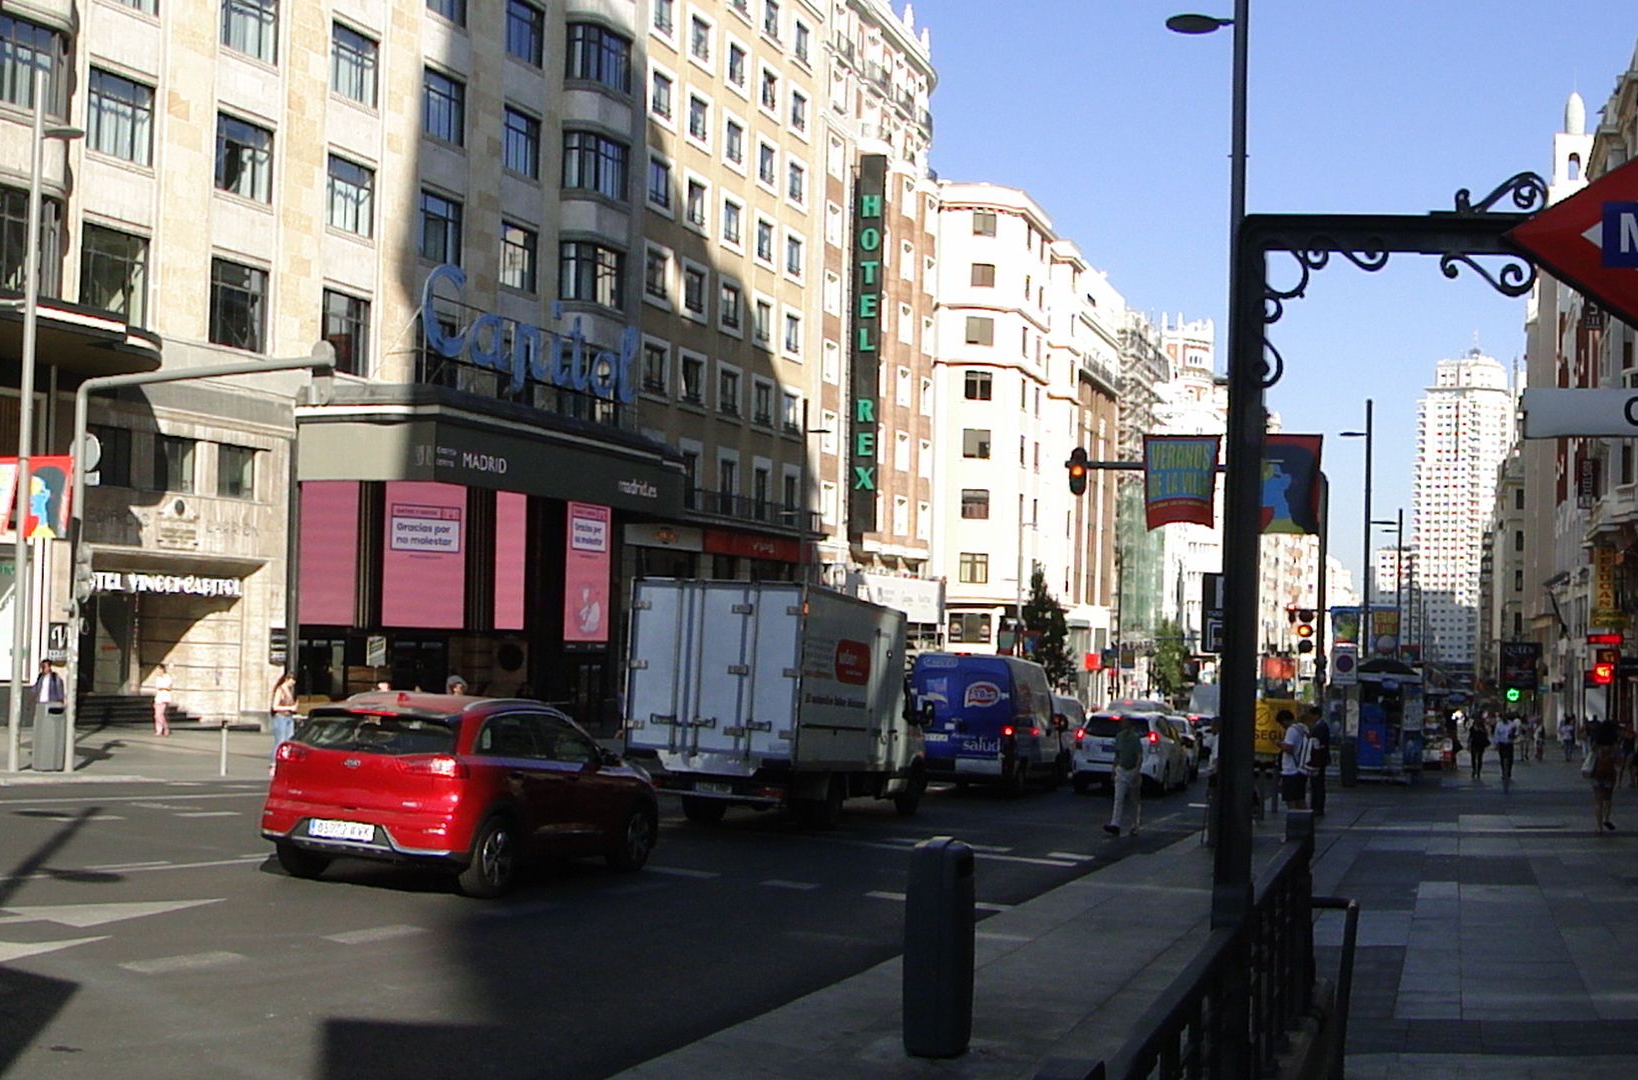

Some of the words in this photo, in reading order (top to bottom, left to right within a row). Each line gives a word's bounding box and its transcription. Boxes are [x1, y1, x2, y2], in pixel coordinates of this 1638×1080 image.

[857, 194, 881, 352] HOTEL
[422, 263, 641, 404] Capitol
[854, 399, 875, 491] REX
[463, 452, 508, 474] MADRID
[396, 521, 433, 533] Gracias
[434, 526, 451, 536] por
[410, 536, 452, 547] molestar
[963, 736, 1001, 752] salud
